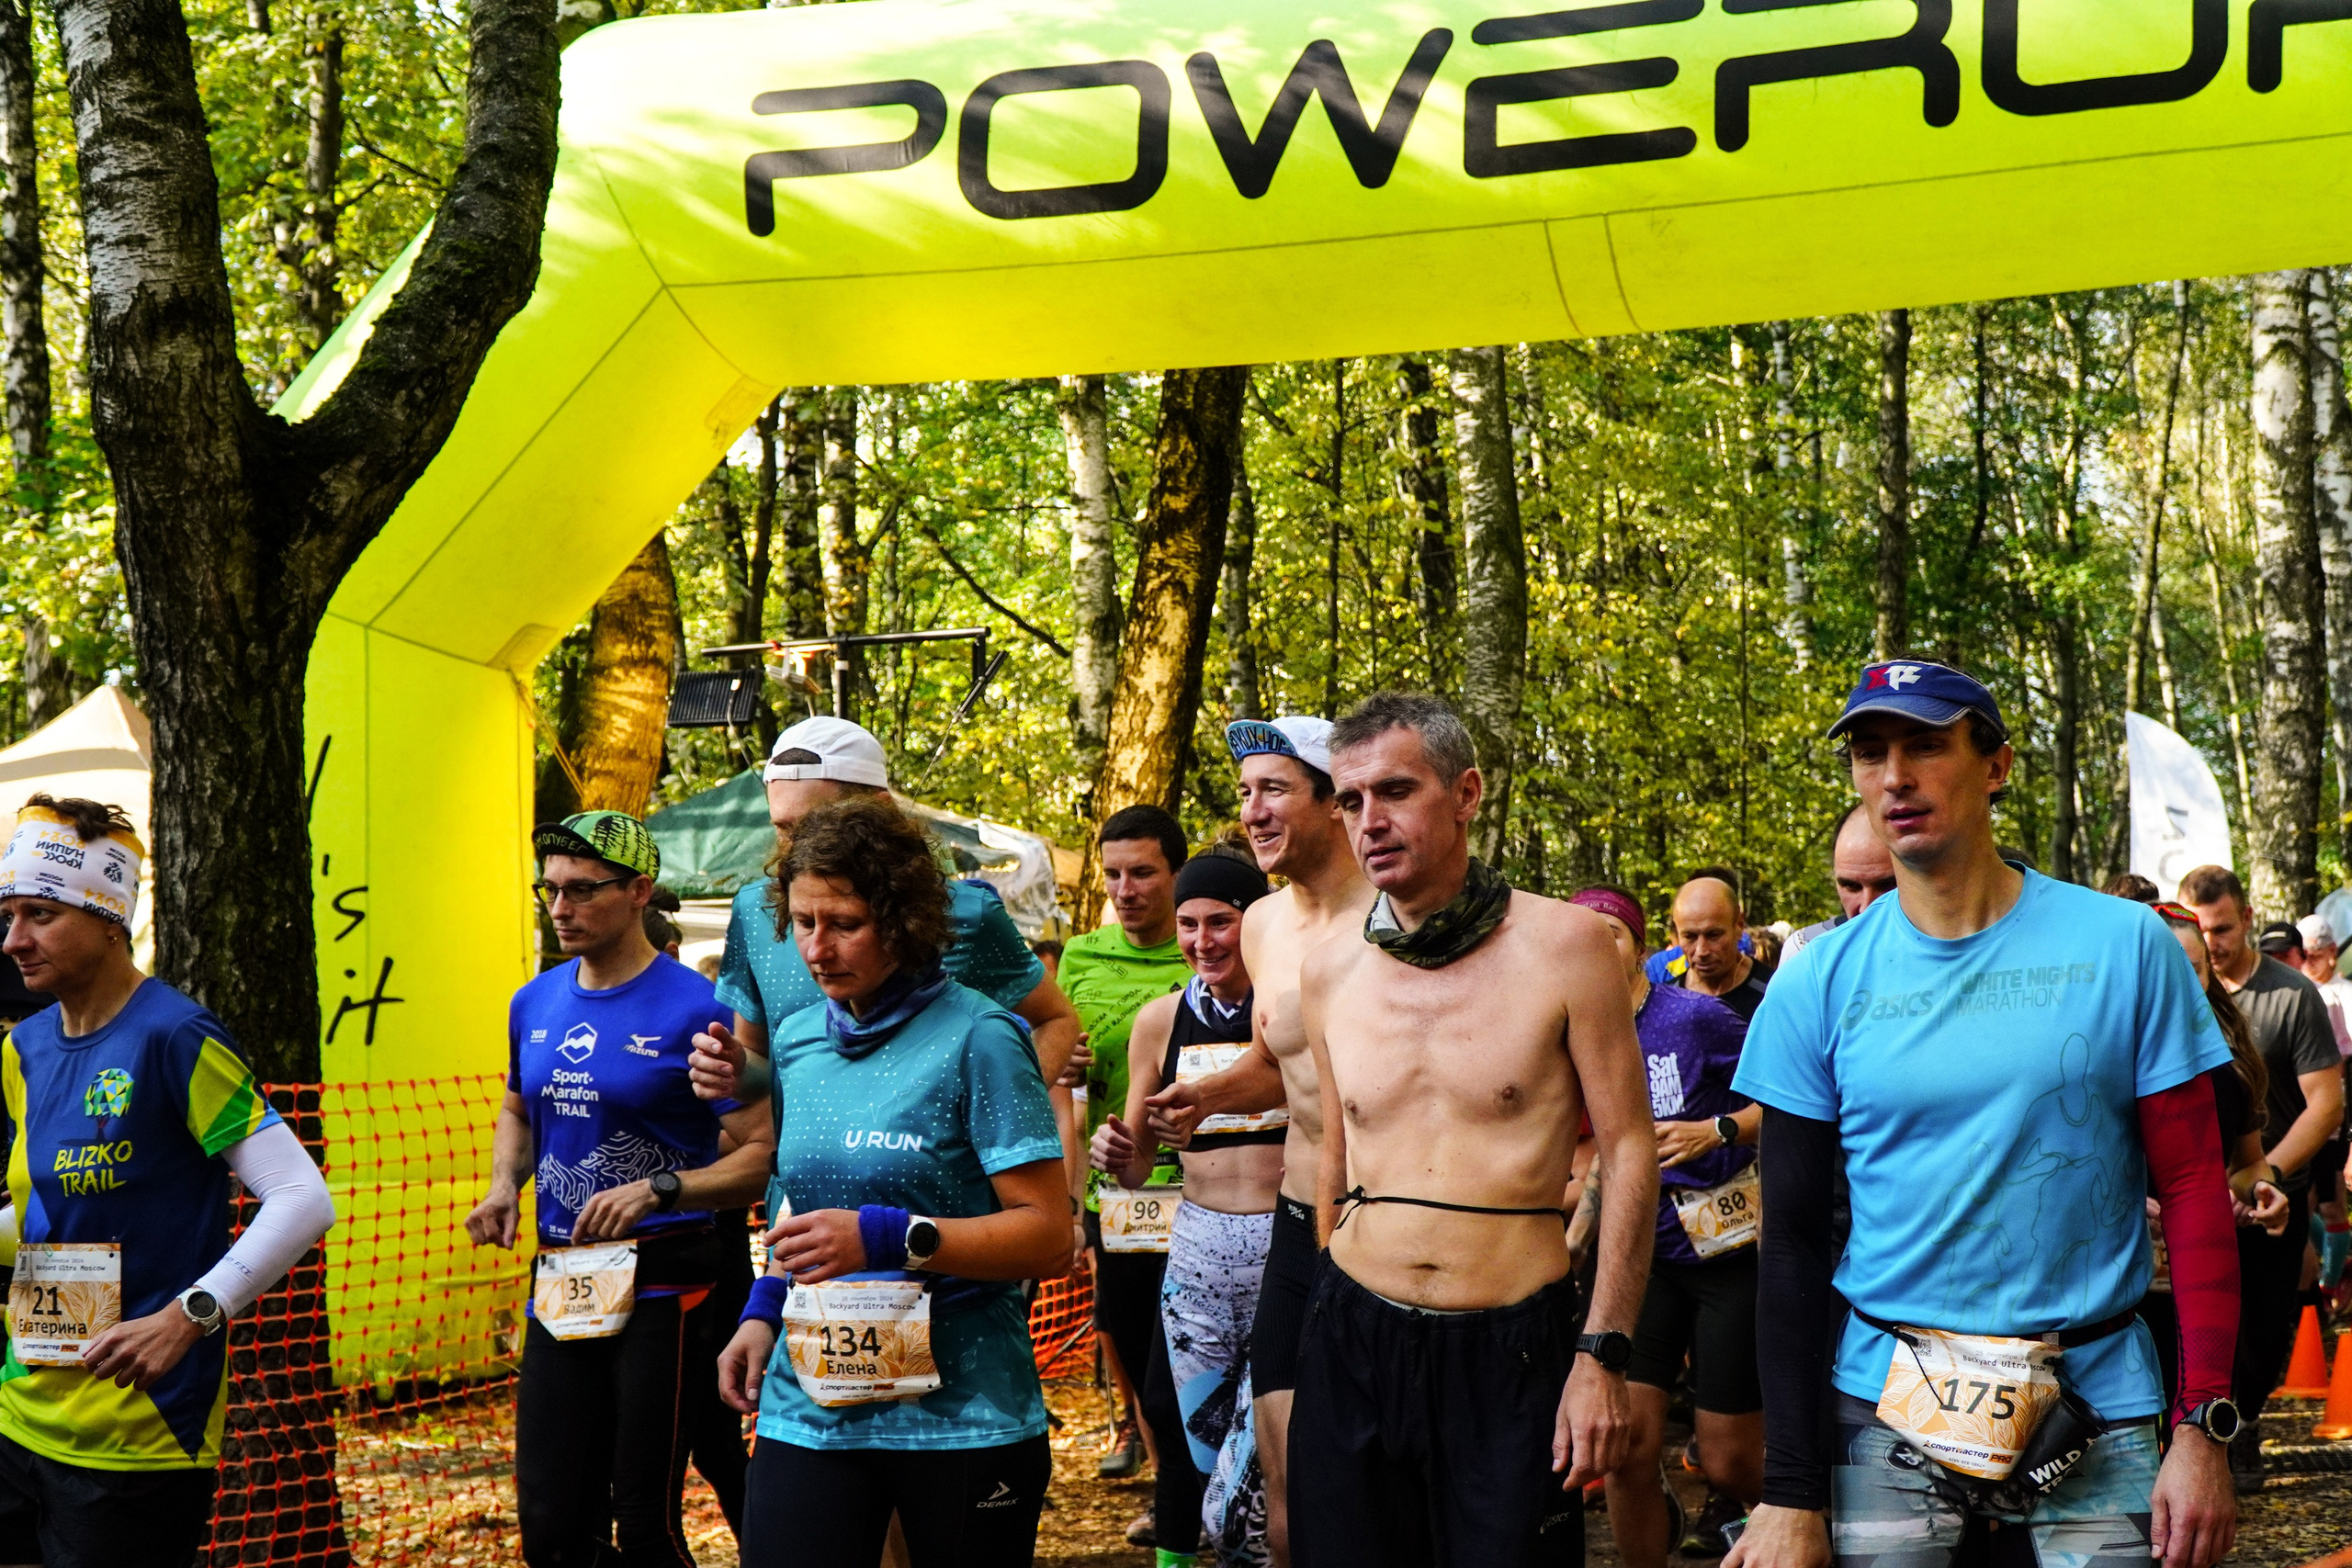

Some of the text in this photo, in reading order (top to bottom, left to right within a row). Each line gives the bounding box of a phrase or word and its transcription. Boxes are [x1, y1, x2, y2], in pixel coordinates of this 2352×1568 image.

[35, 840, 85, 860] НАЦИИ
[43, 852, 83, 870] КРОСС
[1960, 968, 2023, 994] WHITE
[2027, 963, 2096, 987] NIGHTS
[1956, 987, 2064, 1017] MARATHON
[531, 1030, 548, 1039] 2018
[1647, 1053, 1680, 1079] Sat
[541, 1084, 599, 1101] Marafon
[1650, 1075, 1682, 1100] 9AM
[553, 1102, 591, 1118] TRAIL
[1652, 1093, 1686, 1119] 5KM
[53, 1140, 133, 1172] BLIZKO
[59, 1168, 127, 1198] TRAIL
[1135, 1201, 1160, 1220] 90
[1717, 1191, 1747, 1216] 80
[1124, 1222, 1168, 1234] Дмитрий
[1722, 1212, 1754, 1229] Ольга
[569, 1277, 593, 1300] 35
[32, 1286, 62, 1315] 21
[564, 1303, 595, 1315] Вадим
[829, 1303, 860, 1311] Backyard
[888, 1303, 916, 1311] Moscow
[19, 1318, 87, 1337] Екатерина
[820, 1326, 882, 1357] 134
[827, 1360, 876, 1375] Елена
[1962, 1355, 1996, 1368] Backyard
[2001, 1360, 2027, 1370] Ultra
[1939, 1378, 2017, 1420] 175
[1930, 1441, 2013, 1465] спортмастер PRO
[2029, 1450, 2082, 1484] WILD
[977, 1497, 1019, 1508] DEMIX
